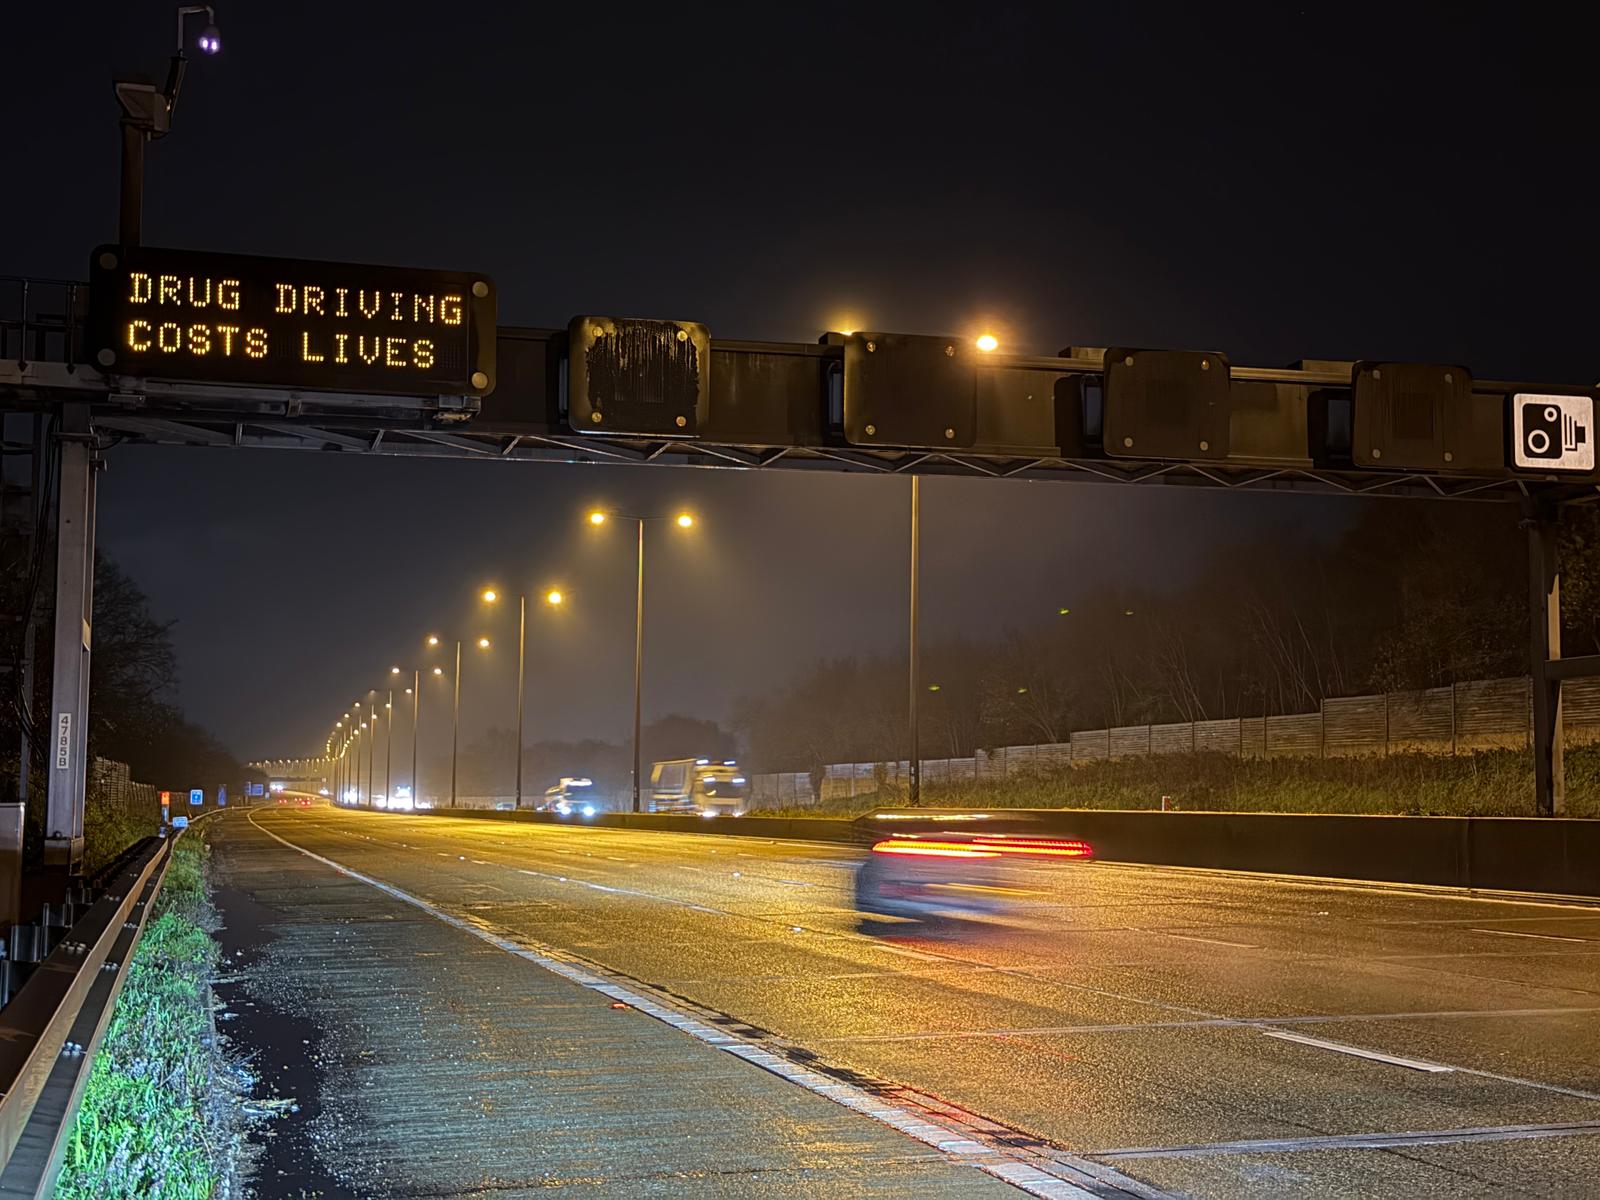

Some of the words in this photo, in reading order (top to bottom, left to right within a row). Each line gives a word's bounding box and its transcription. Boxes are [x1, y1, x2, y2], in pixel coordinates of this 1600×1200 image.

[127, 271, 242, 311] DRUG
[273, 282, 464, 326] DRIVING
[126, 318, 270, 359] COSTS
[301, 330, 436, 370] LIVES
[59, 716, 69, 767] 4785B
